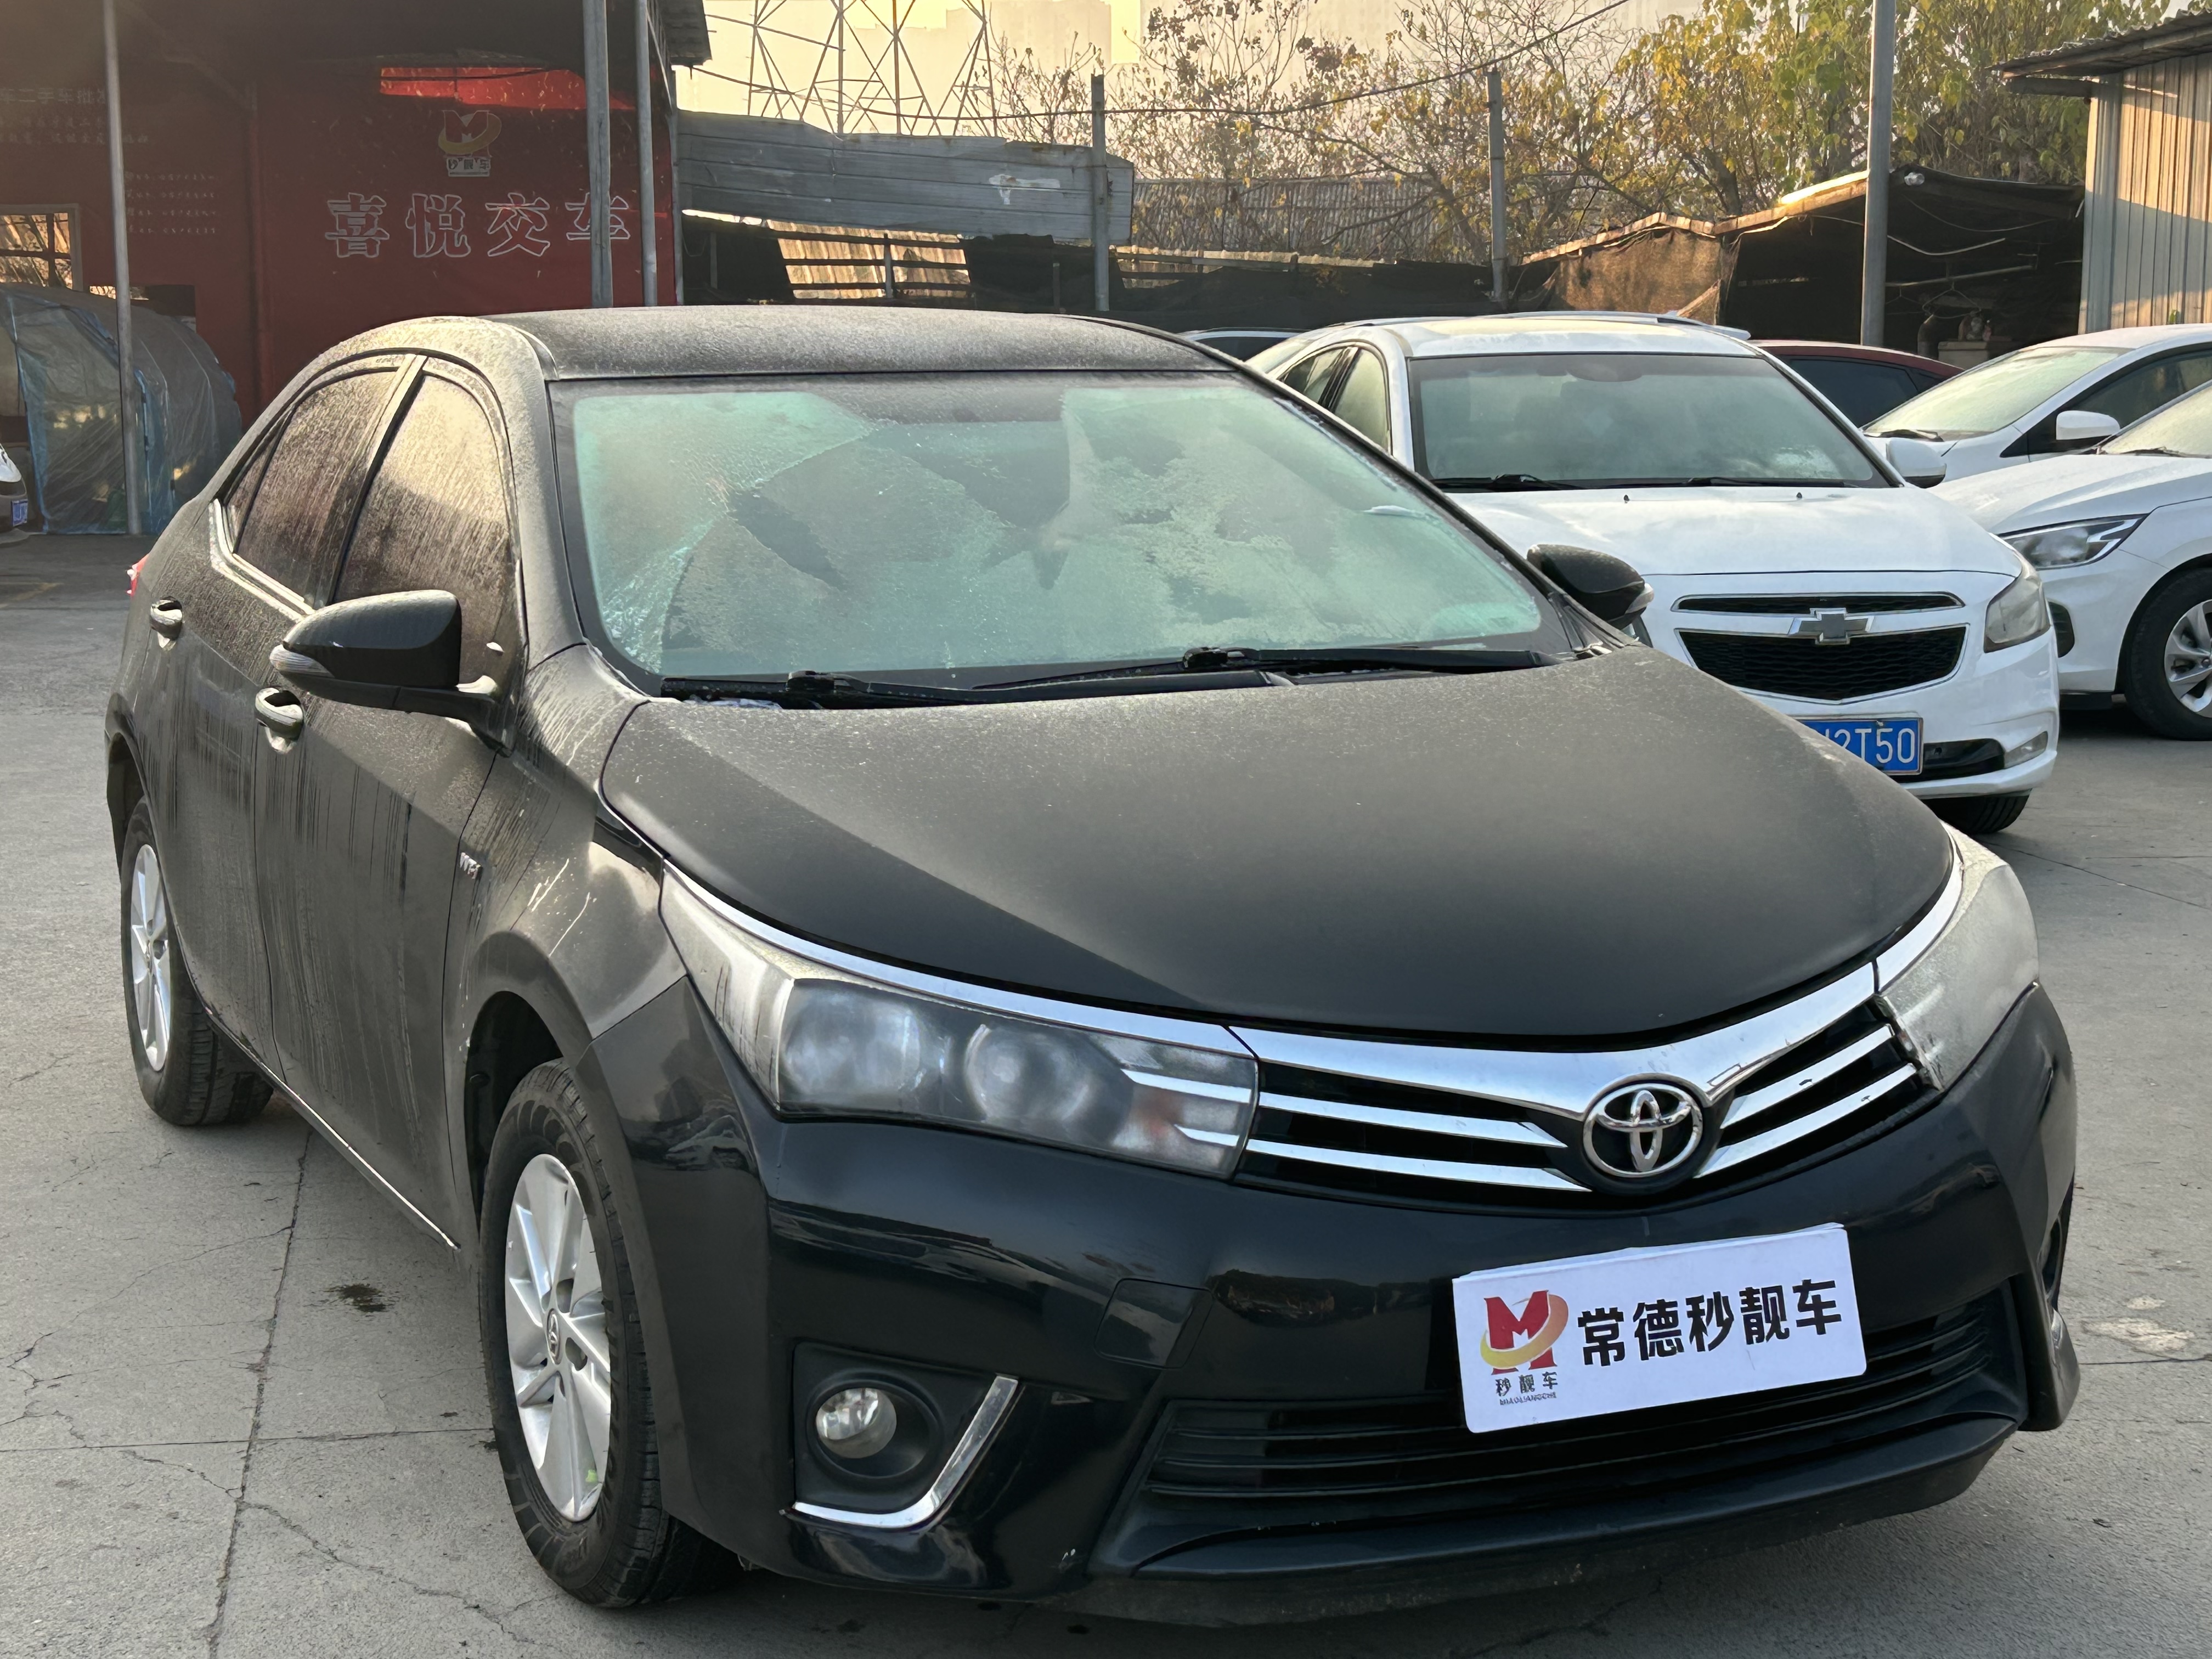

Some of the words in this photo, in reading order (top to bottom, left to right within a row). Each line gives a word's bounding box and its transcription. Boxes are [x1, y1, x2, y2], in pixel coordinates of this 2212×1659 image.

[1825, 728, 1915, 764] 2T50
[1578, 1279, 1842, 1366] 常德秒靓车
